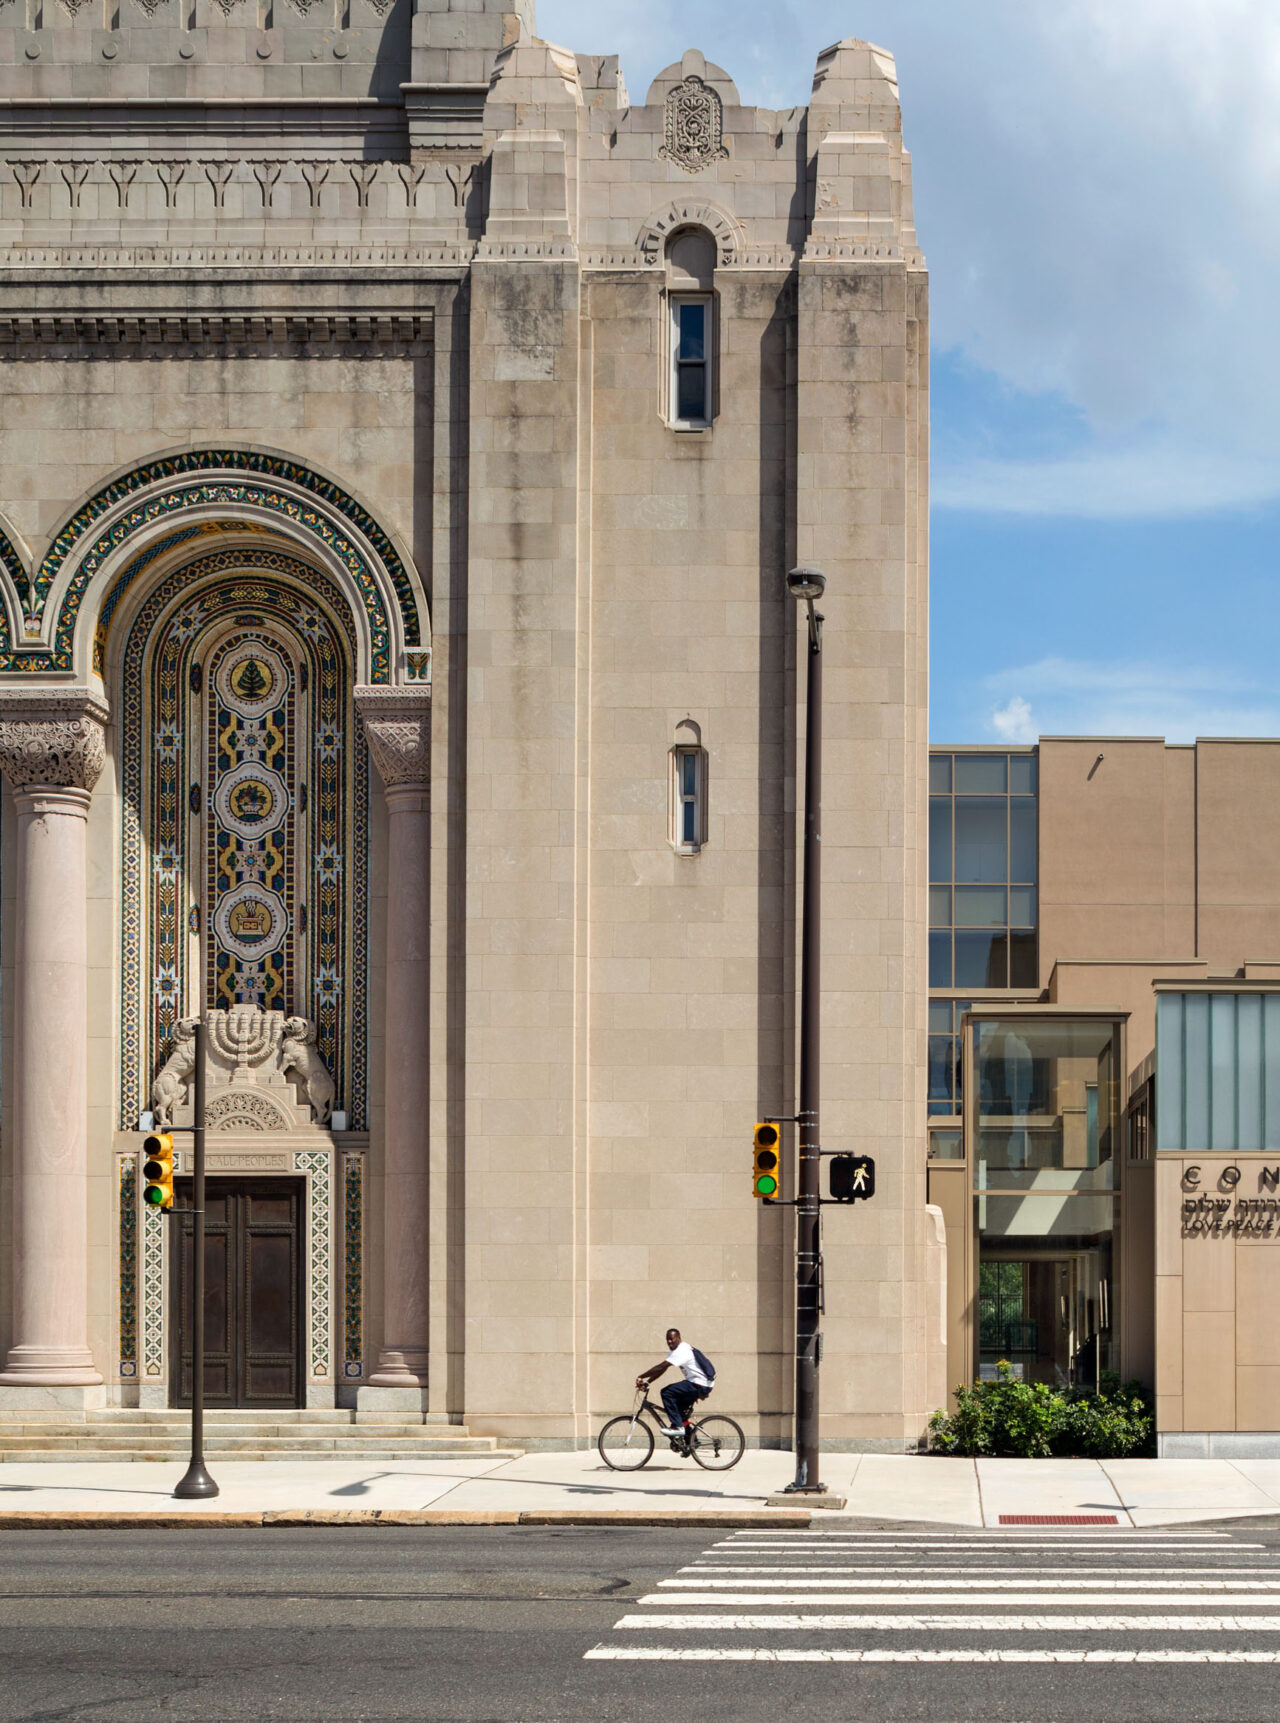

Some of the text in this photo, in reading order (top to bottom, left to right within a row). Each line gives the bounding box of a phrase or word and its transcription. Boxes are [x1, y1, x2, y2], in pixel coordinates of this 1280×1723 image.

[216, 1156, 236, 1166] ALL
[238, 1156, 284, 1166] PEOPLES
[1185, 1192, 1232, 1213] שלום
[1185, 1220, 1223, 1231] LOVE
[1227, 1220, 1275, 1231] PEACE
